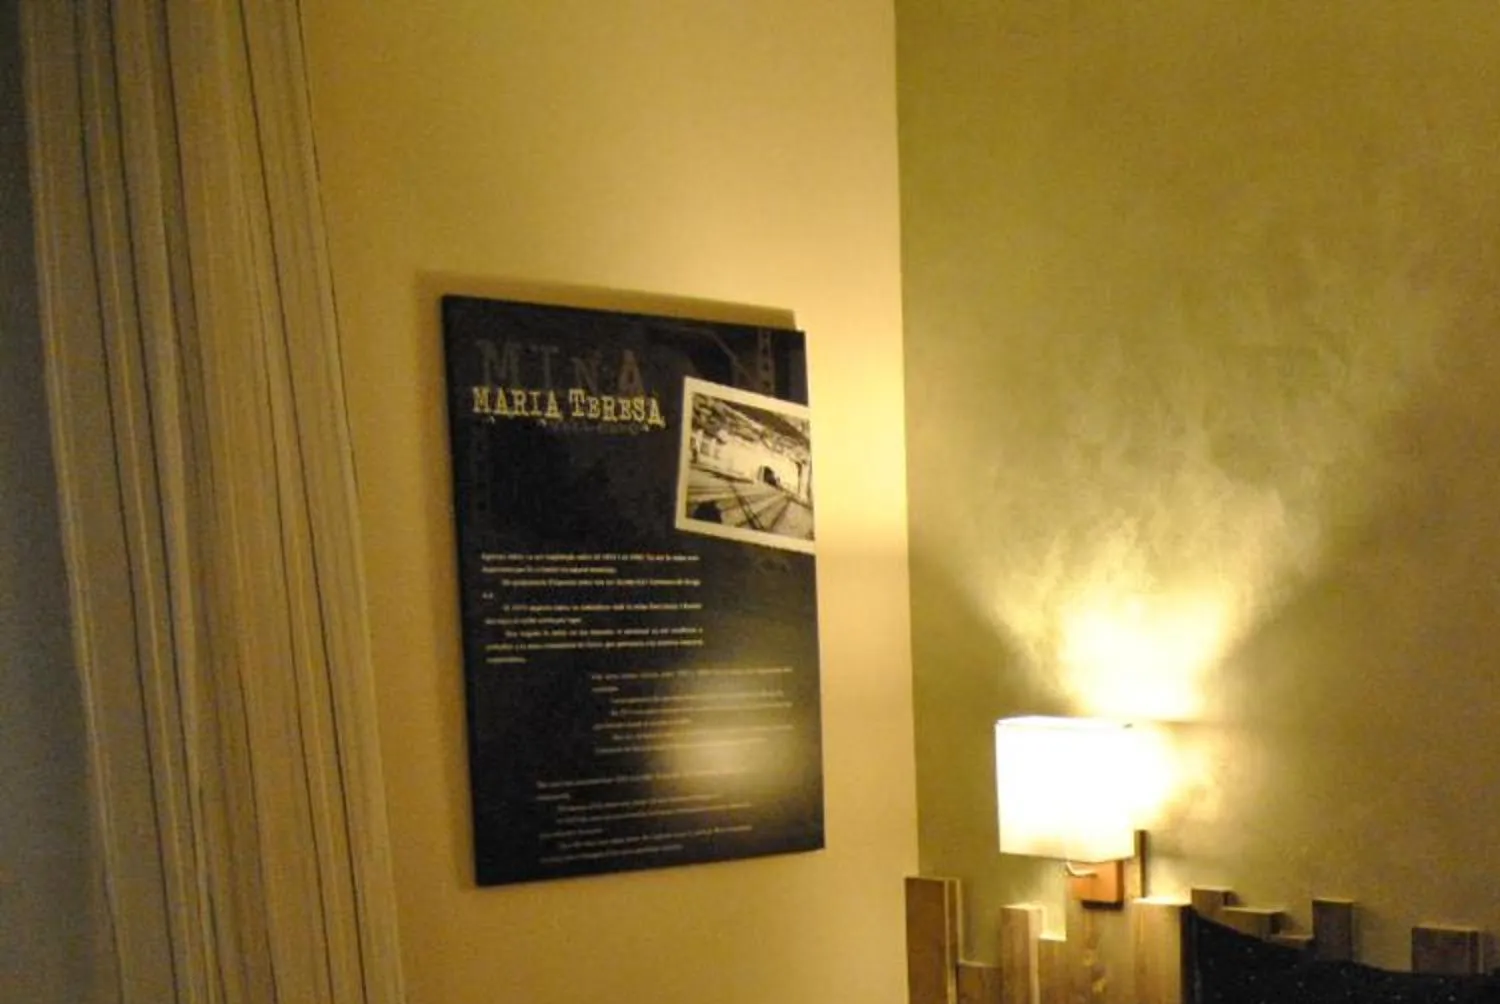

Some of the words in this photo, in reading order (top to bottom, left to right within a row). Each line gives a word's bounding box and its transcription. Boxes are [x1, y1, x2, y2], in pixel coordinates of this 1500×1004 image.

[475, 339, 646, 394] MINA
[471, 385, 562, 421] MARIA
[568, 387, 667, 429] TERESA
